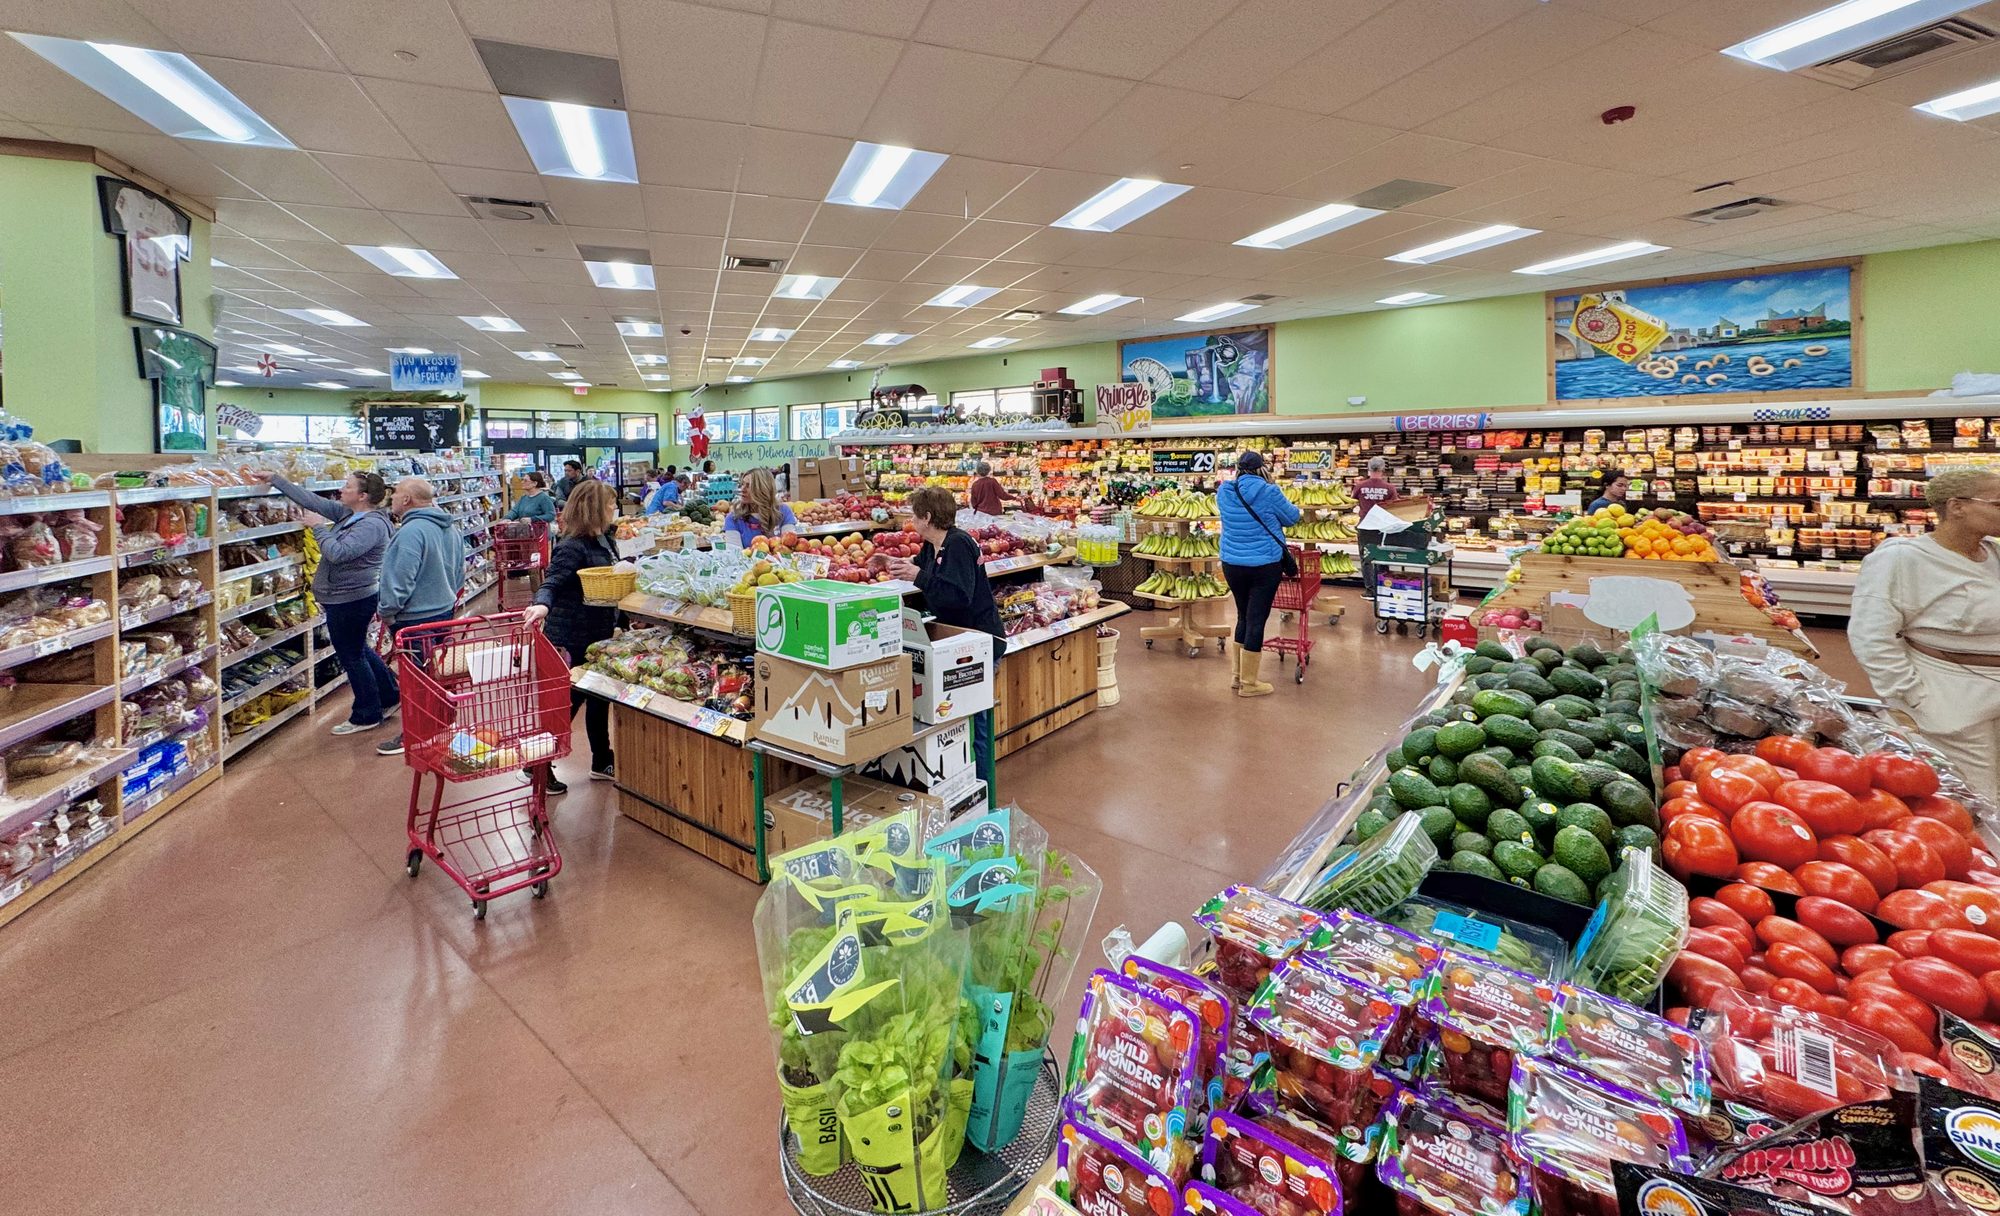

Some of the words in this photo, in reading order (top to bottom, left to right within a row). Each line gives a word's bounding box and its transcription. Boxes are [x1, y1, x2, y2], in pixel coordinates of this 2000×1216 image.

[1625, 319, 1637, 343] JOE'S
[421, 371, 455, 381] FRIEND
[1096, 383, 1150, 415] Kringle
[1404, 414, 1478, 430] BERRIES
[725, 446, 753, 463] Flowers
[756, 445, 796, 462] Delivered
[1360, 487, 1388, 495] TRADER
[953, 643, 975, 656] APPLES
[859, 662, 900, 685] Rainier
[813, 731, 840, 746] Rainier
[936, 723, 966, 748] Rainier
[1233, 906, 1288, 932] WONDERS
[1251, 907, 1279, 921] WILD
[1342, 937, 1408, 970] WONDERS
[1362, 938, 1394, 957] WILD
[1310, 989, 1346, 1012] WILD
[1454, 982, 1531, 1016] WONDERS
[1474, 980, 1514, 1001] WILD
[1289, 989, 1358, 1027] WONDERS
[1120, 1031, 1148, 1049] ORGANIC
[1579, 1022, 1672, 1066] WONDERS
[1602, 1022, 1648, 1047] WILD
[1114, 1035, 1149, 1064] WILD
[1097, 1042, 1162, 1090] WONDERS
[1542, 1105, 1646, 1155] WONDERS
[1566, 1104, 1618, 1133] WILD
[1840, 1114, 1890, 1125] Saucing
[1410, 1133, 1499, 1184] WONDERS
[1434, 1134, 1478, 1161] WILD
[1428, 1153, 1474, 1179] BIOLOGIQUE
[1779, 1169, 1809, 1184] SUPER
[1810, 1174, 1846, 1189] TUSCAN
[1099, 1188, 1127, 1211] ORGANIC
[1767, 1199, 1815, 1215] Greenhouse
